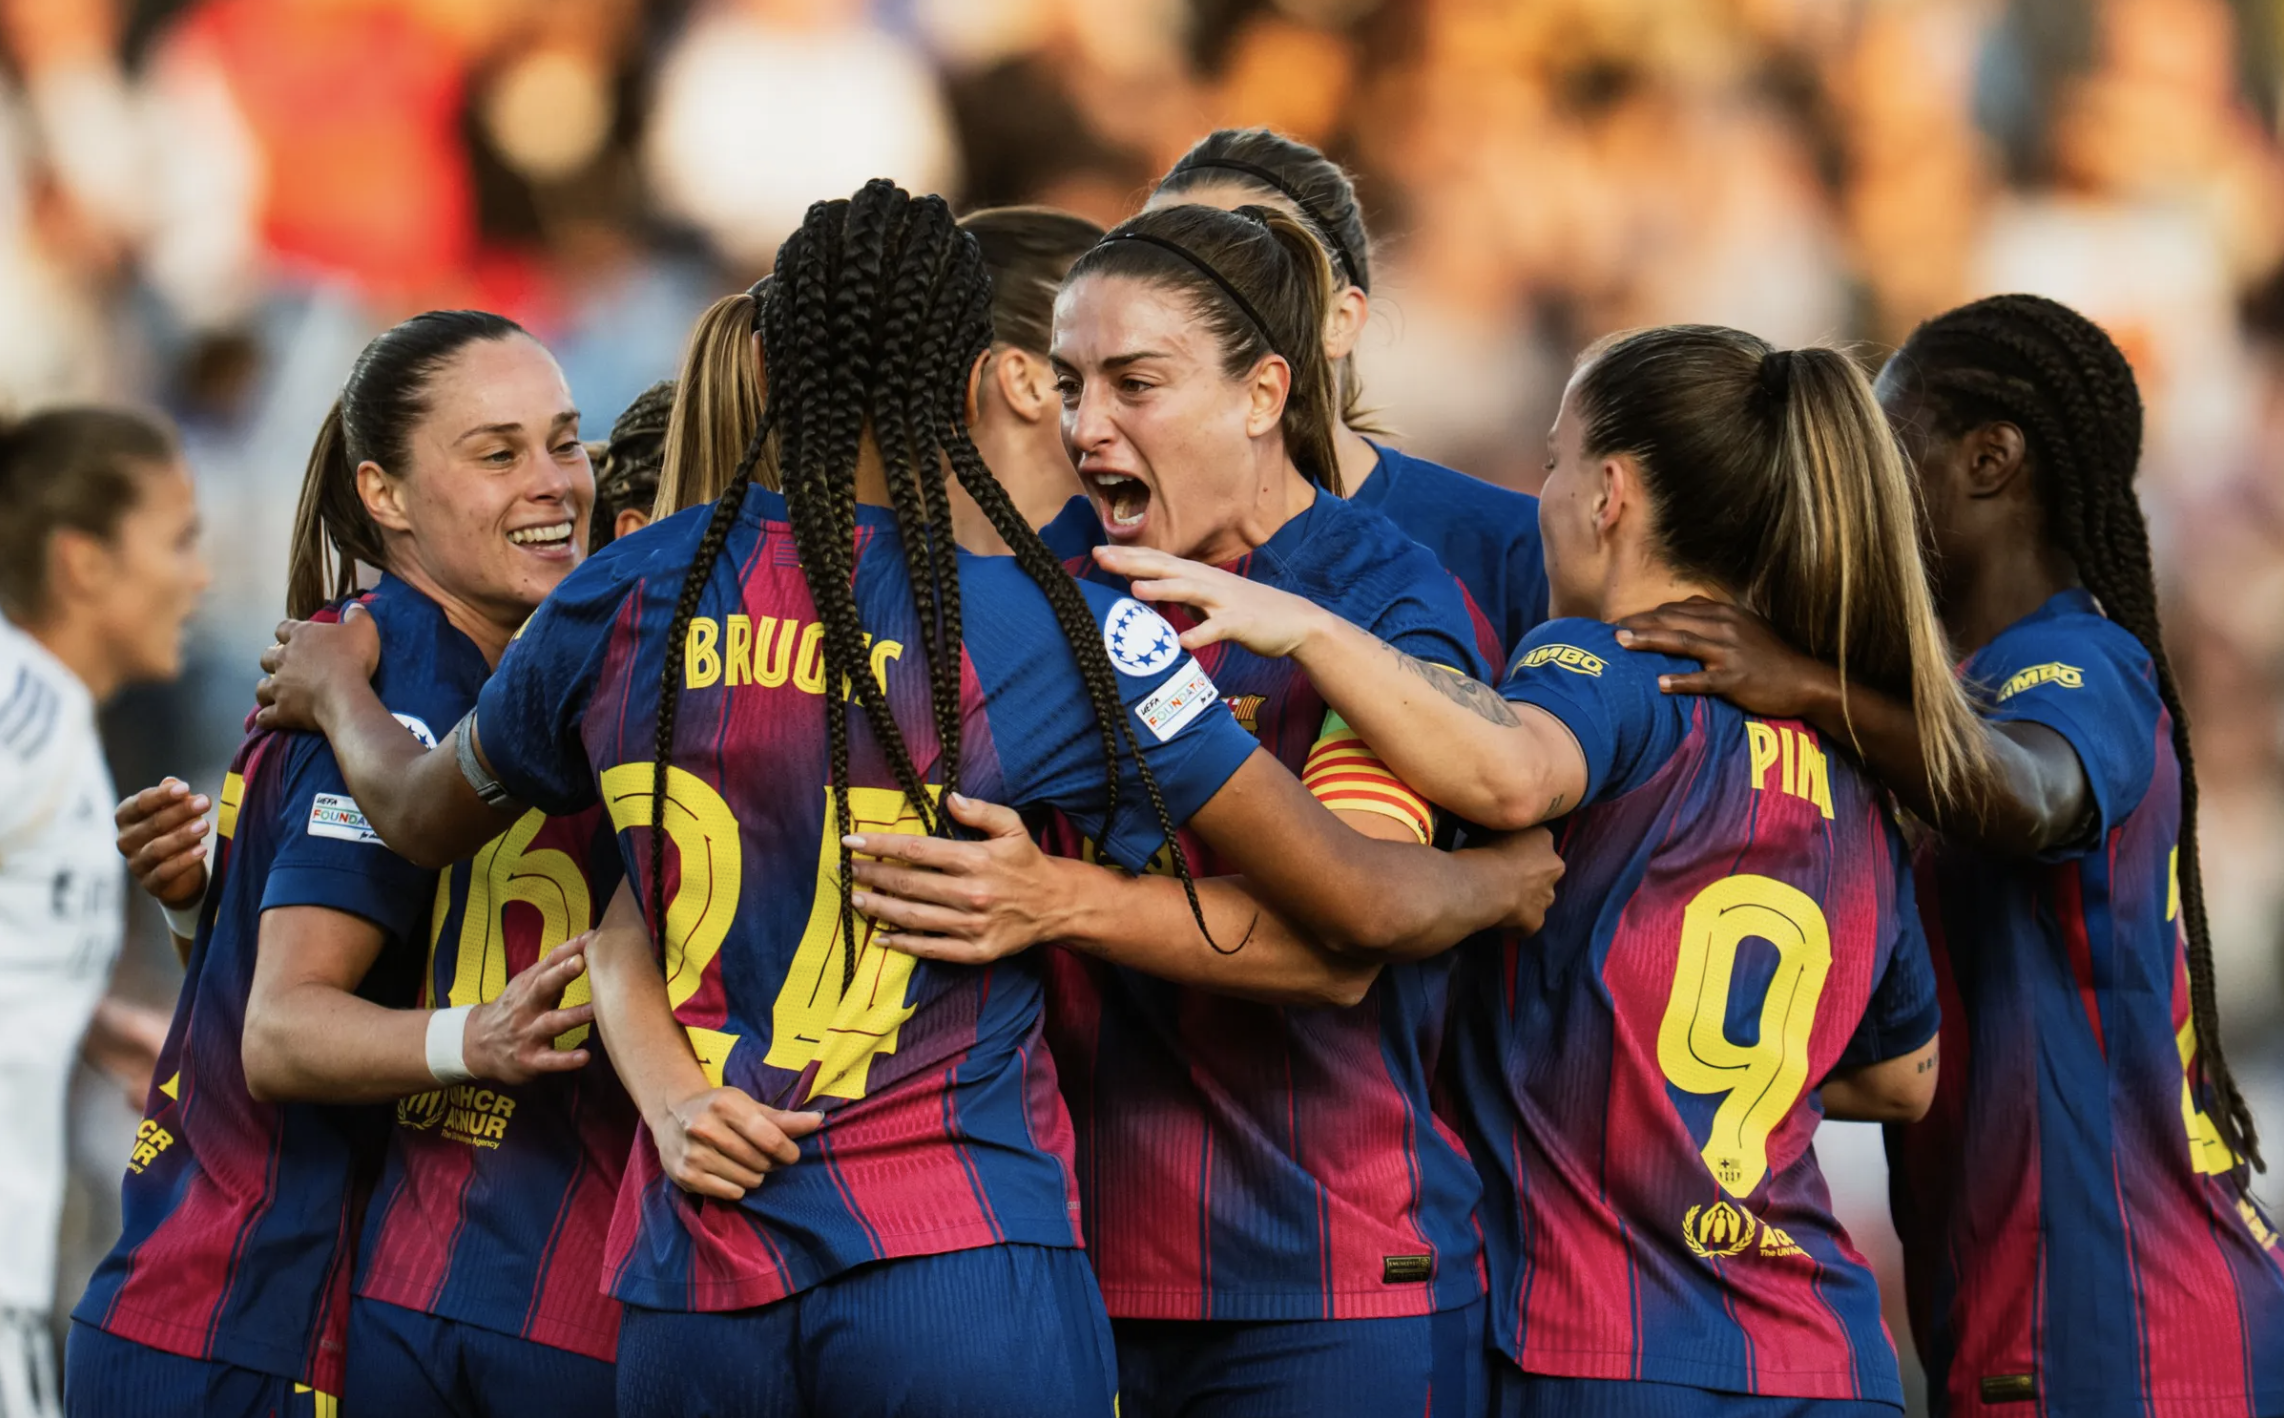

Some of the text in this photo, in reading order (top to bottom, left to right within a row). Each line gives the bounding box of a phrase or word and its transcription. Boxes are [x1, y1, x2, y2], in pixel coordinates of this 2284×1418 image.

[1140, 697, 1161, 716] UEFA
[316, 796, 338, 806] UEFA
[1657, 873, 1834, 1199] 9
